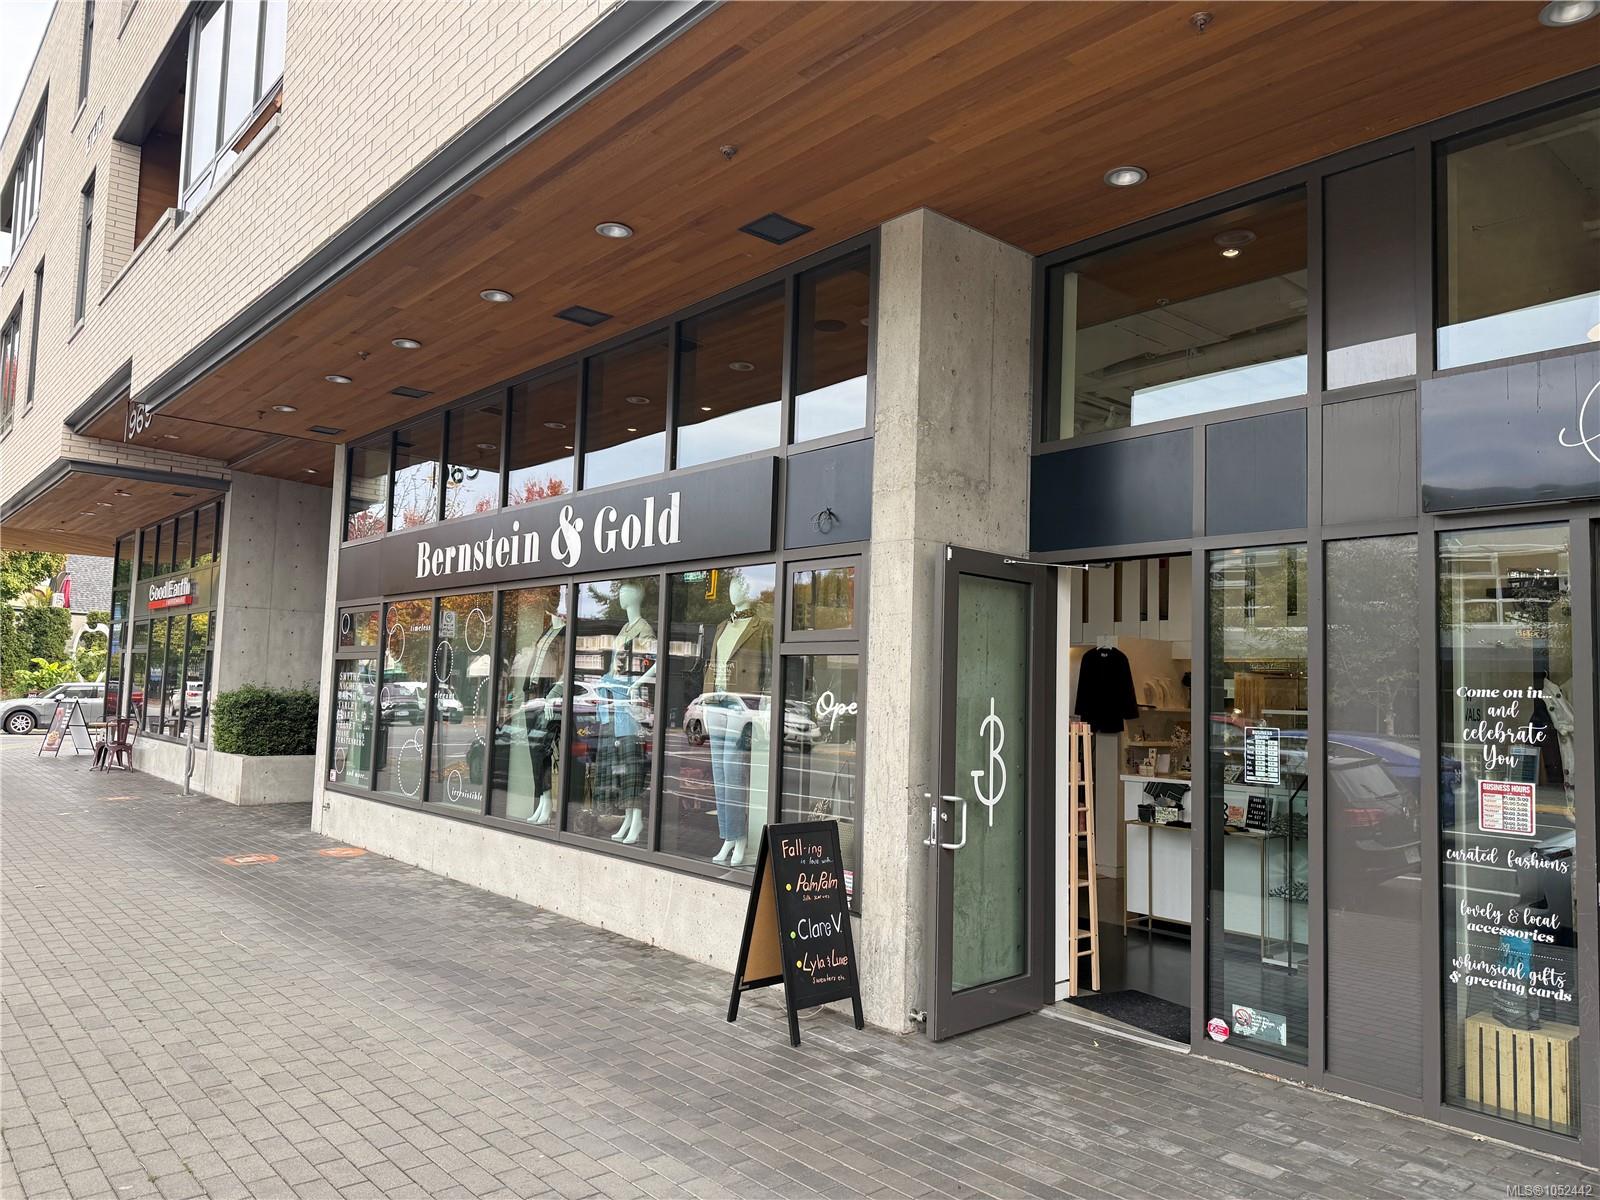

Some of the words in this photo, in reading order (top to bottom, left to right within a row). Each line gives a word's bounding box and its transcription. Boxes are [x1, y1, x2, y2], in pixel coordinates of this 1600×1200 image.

[415, 520, 541, 579] Bernstein
[551, 504, 584, 568] &
[593, 491, 681, 554] Gold
[1456, 686, 1500, 698] Come
[1502, 689, 1523, 699] on
[1527, 686, 1552, 699] in...
[816, 690, 858, 732] Ope
[1487, 700, 1520, 718] and
[1462, 720, 1548, 744] celebrate
[1482, 744, 1519, 769] You
[1482, 782, 1511, 792] BUSINESS
[1511, 785, 1531, 794] HOURS
[781, 838, 823, 859] Fall-ing
[1446, 846, 1498, 864] curated
[1507, 849, 1570, 874] fashions
[1460, 899, 1503, 925] lovely
[1508, 908, 1520, 924] &
[1523, 908, 1561, 930] local
[797, 917, 832, 940] Clare
[1466, 922, 1556, 943] accessories
[802, 951, 826, 977] Lyla
[1452, 953, 1526, 980] whimsical
[1528, 966, 1567, 989] gifts
[1449, 970, 1461, 984] &
[1465, 974, 1526, 996] greeting
[1528, 986, 1573, 1002] cards
